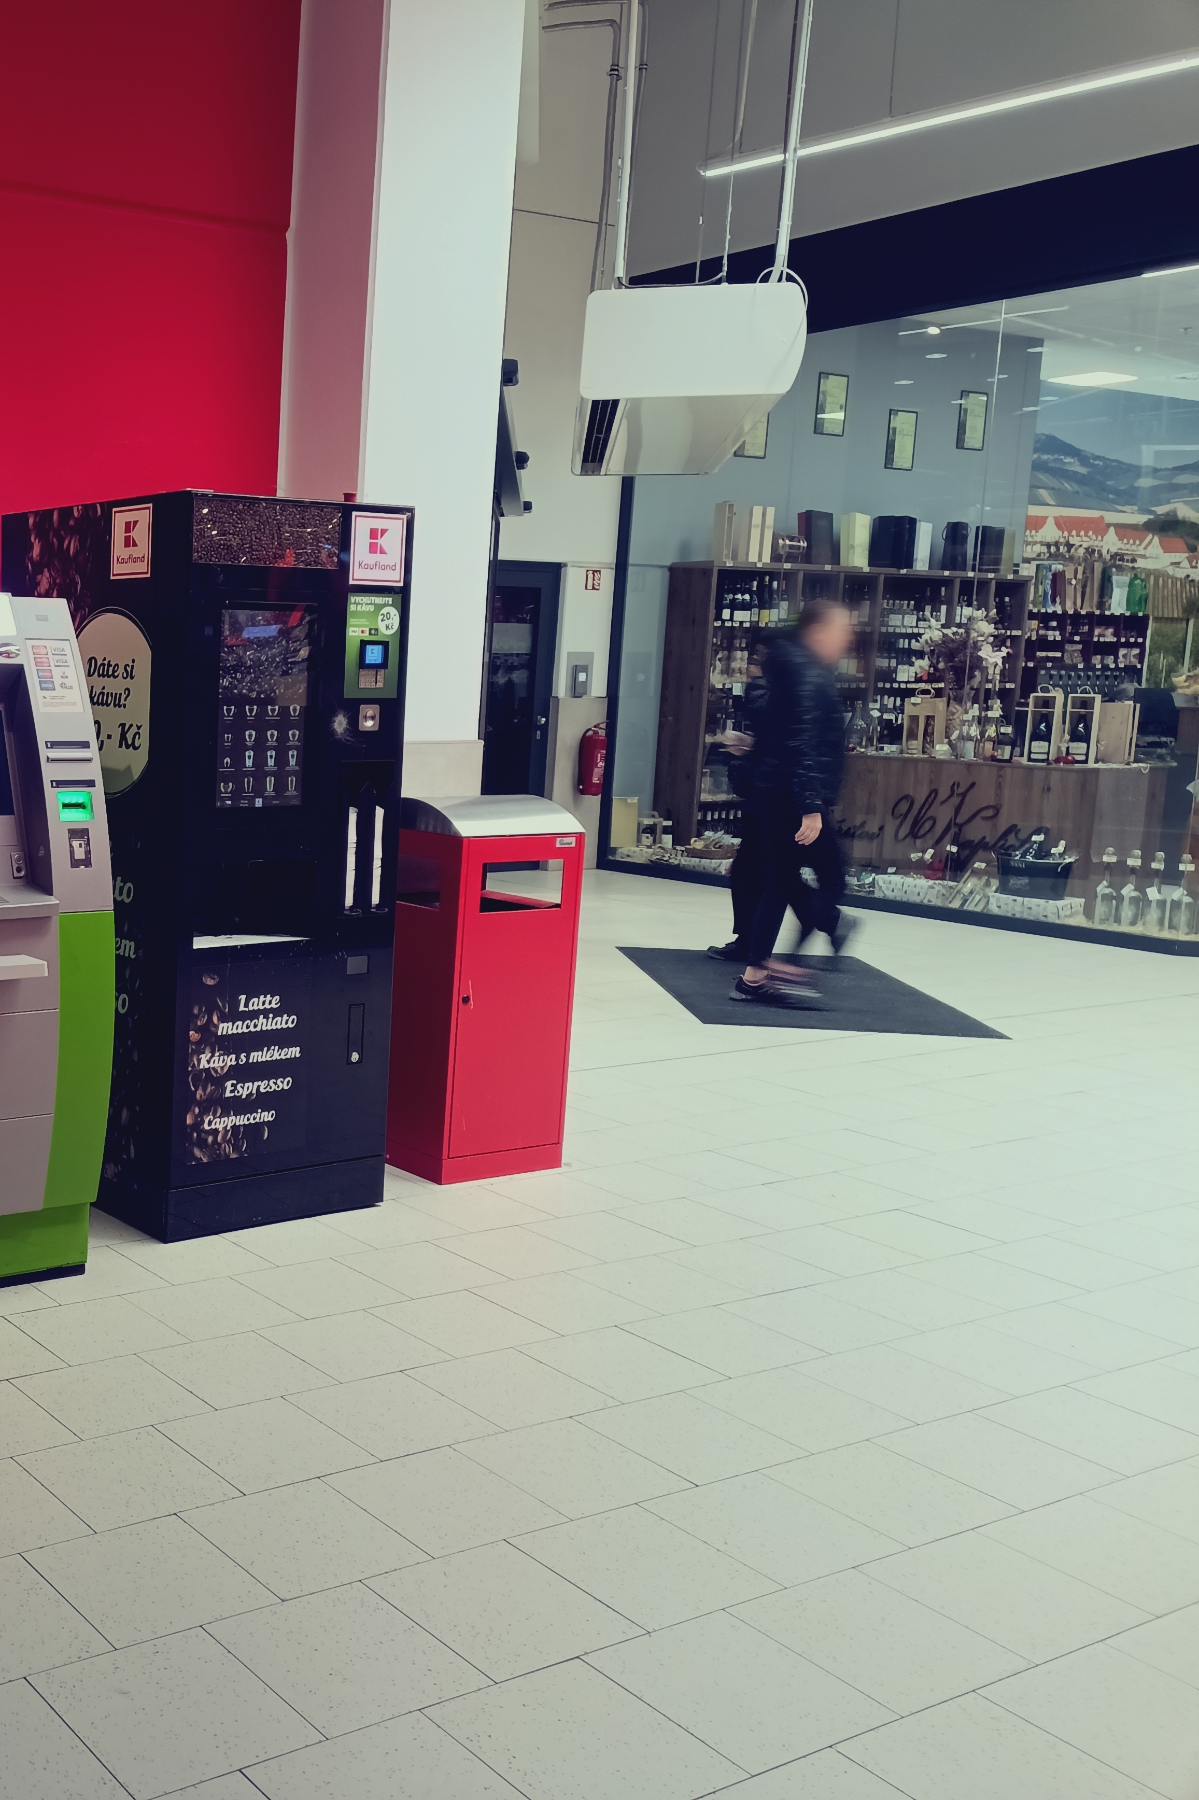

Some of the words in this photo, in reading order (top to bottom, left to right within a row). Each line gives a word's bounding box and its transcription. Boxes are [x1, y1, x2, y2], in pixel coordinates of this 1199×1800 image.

[116, 553, 145, 565] Kaufland
[358, 559, 397, 572] Kaufland
[357, 603, 374, 611] KÁVU
[380, 611, 397, 622] 20,-
[385, 622, 394, 631] Kč
[87, 656, 120, 680] Dáte
[122, 658, 136, 680] si
[89, 685, 131, 708] kávu?
[117, 722, 143, 751] Kč
[238, 994, 281, 1012] Latte
[217, 1013, 298, 1036] macchiato
[198, 1053, 237, 1070] Káva
[238, 1055, 247, 1065] s
[248, 1044, 301, 1064] mlékem
[224, 1076, 293, 1099] Espresso
[203, 1109, 276, 1132] Cappuccino
